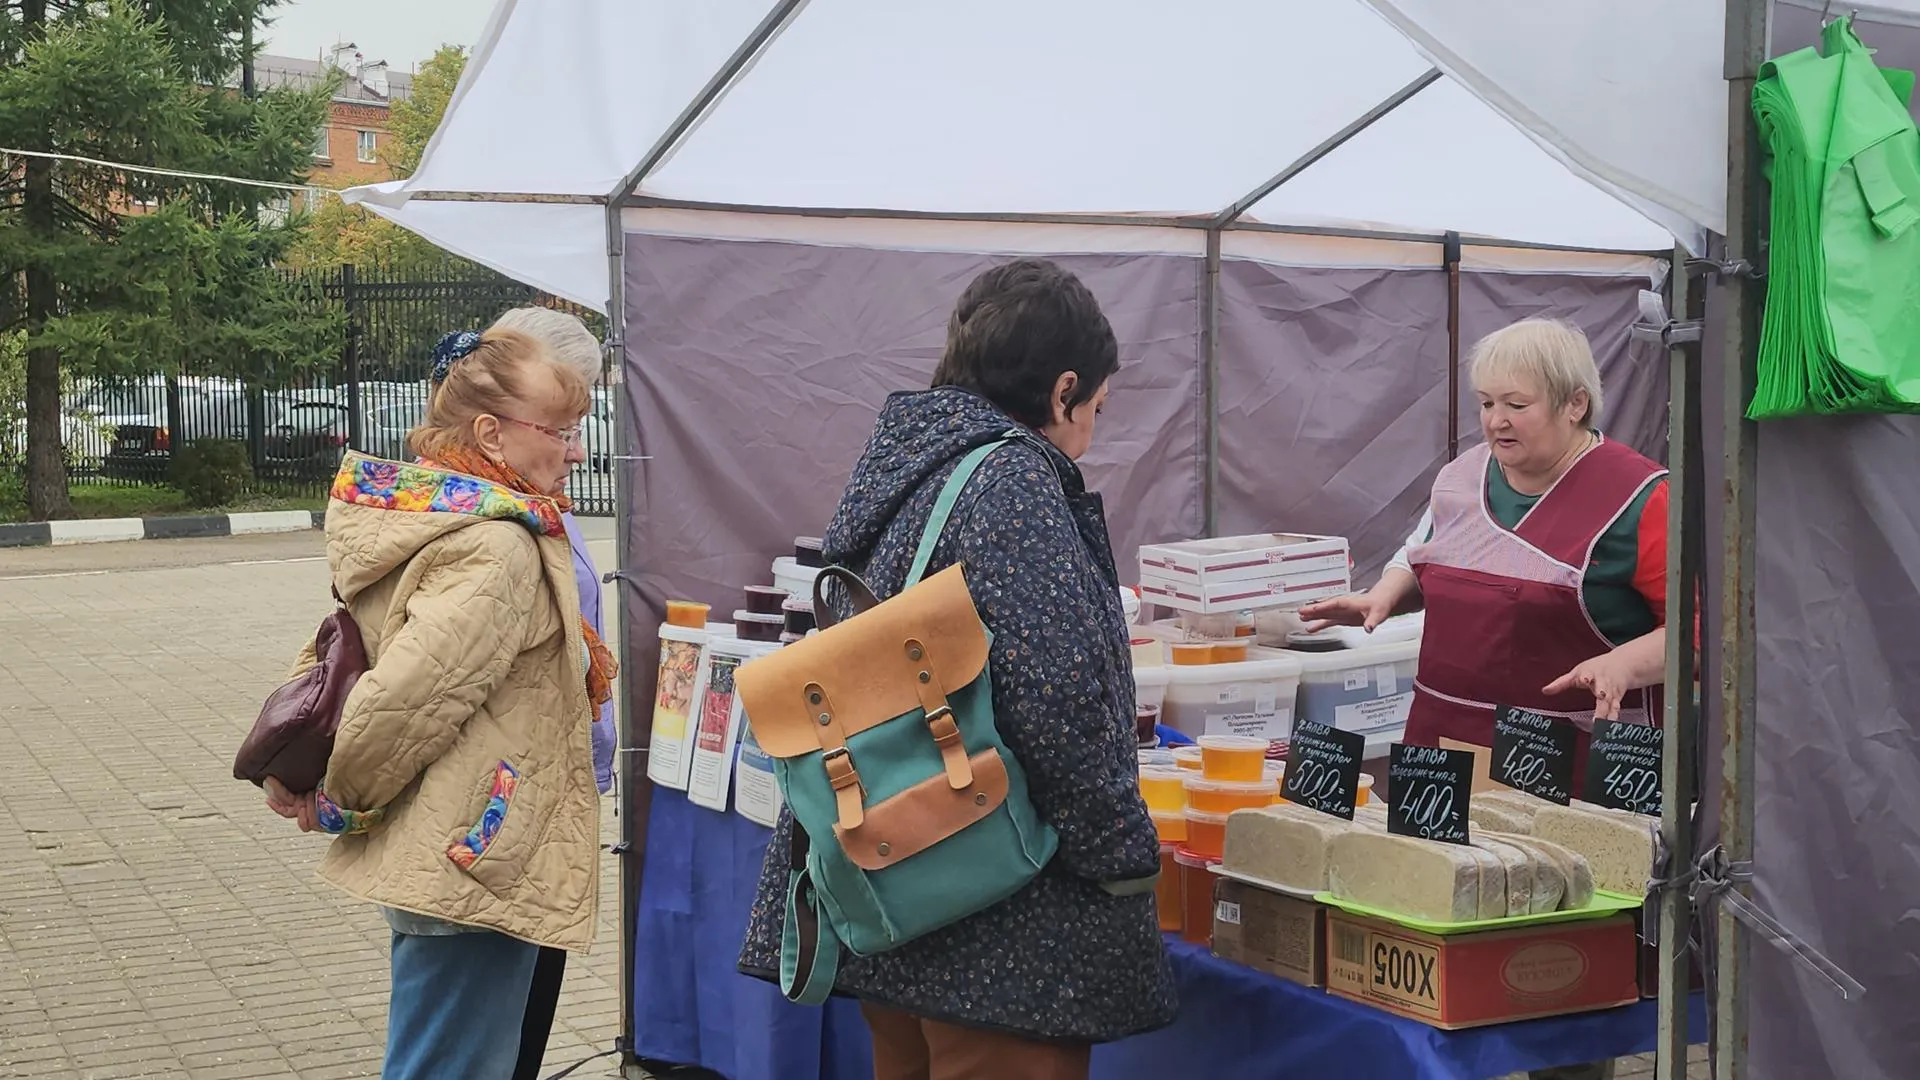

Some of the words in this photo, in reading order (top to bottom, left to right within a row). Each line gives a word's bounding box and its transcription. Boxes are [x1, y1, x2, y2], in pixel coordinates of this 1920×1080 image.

[1507, 708, 1552, 731] ХАЛВА
[1606, 722, 1663, 744] ХАЛВА
[1402, 747, 1448, 765] ХАЛВА
